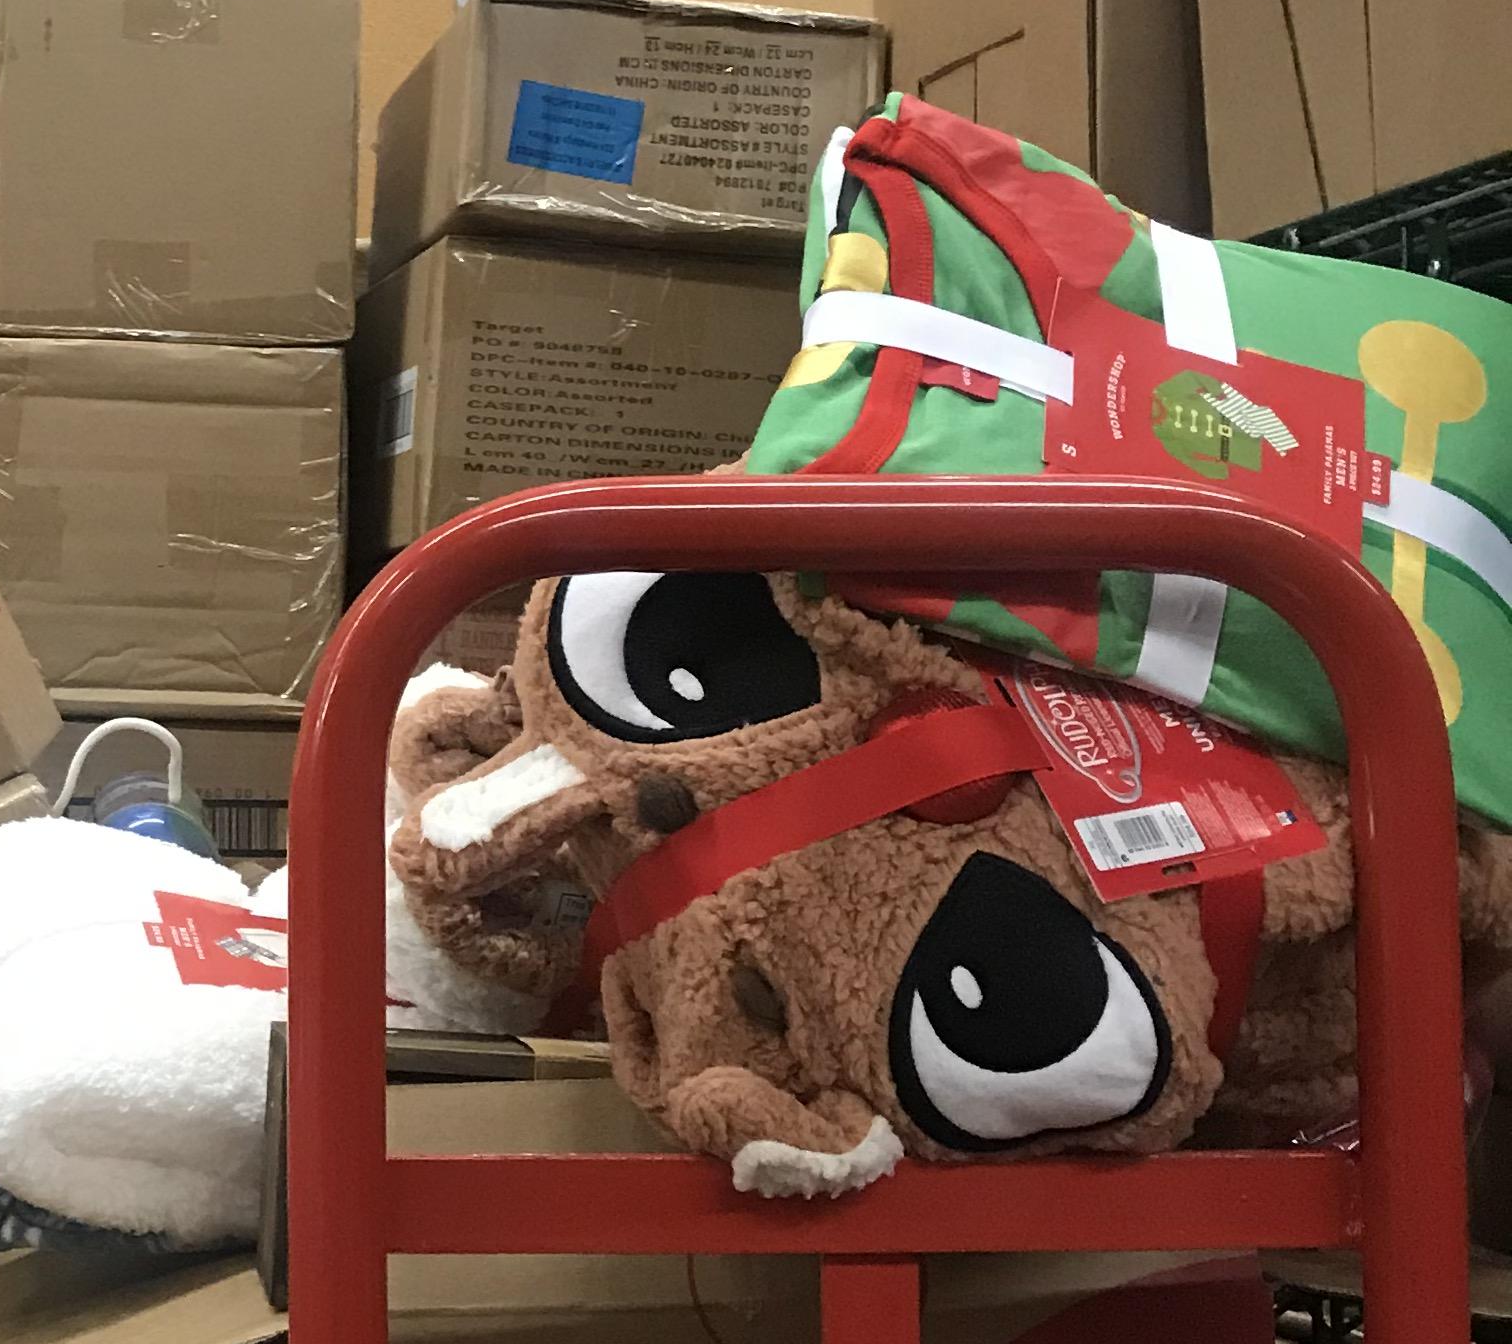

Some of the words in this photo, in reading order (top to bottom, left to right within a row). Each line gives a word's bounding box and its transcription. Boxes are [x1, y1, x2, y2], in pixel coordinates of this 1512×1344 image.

[618, 57, 640, 70] CM
[661, 60, 749, 77] DIMENSIONS
[753, 66, 812, 80] CARTON
[615, 75, 659, 90] CHINA
[662, 78, 717, 93] ORIGIN:
[721, 84, 739, 95] OF
[743, 84, 811, 98] COUNTRY
[670, 116, 750, 131] ASSORTED
[755, 122, 809, 136] COLOR:
[761, 197, 806, 213] Target
[473, 320, 544, 334] Target
[1107, 354, 1127, 440] WONDERSHOP
[466, 415, 578, 433] COUNTRY
[587, 424, 614, 436] OF
[465, 431, 562, 447] CARTON
[568, 438, 715, 457] DIMENSIONS
[1061, 443, 1077, 457] S
[463, 462, 532, 477] MADE
[538, 466, 561, 477] IN
